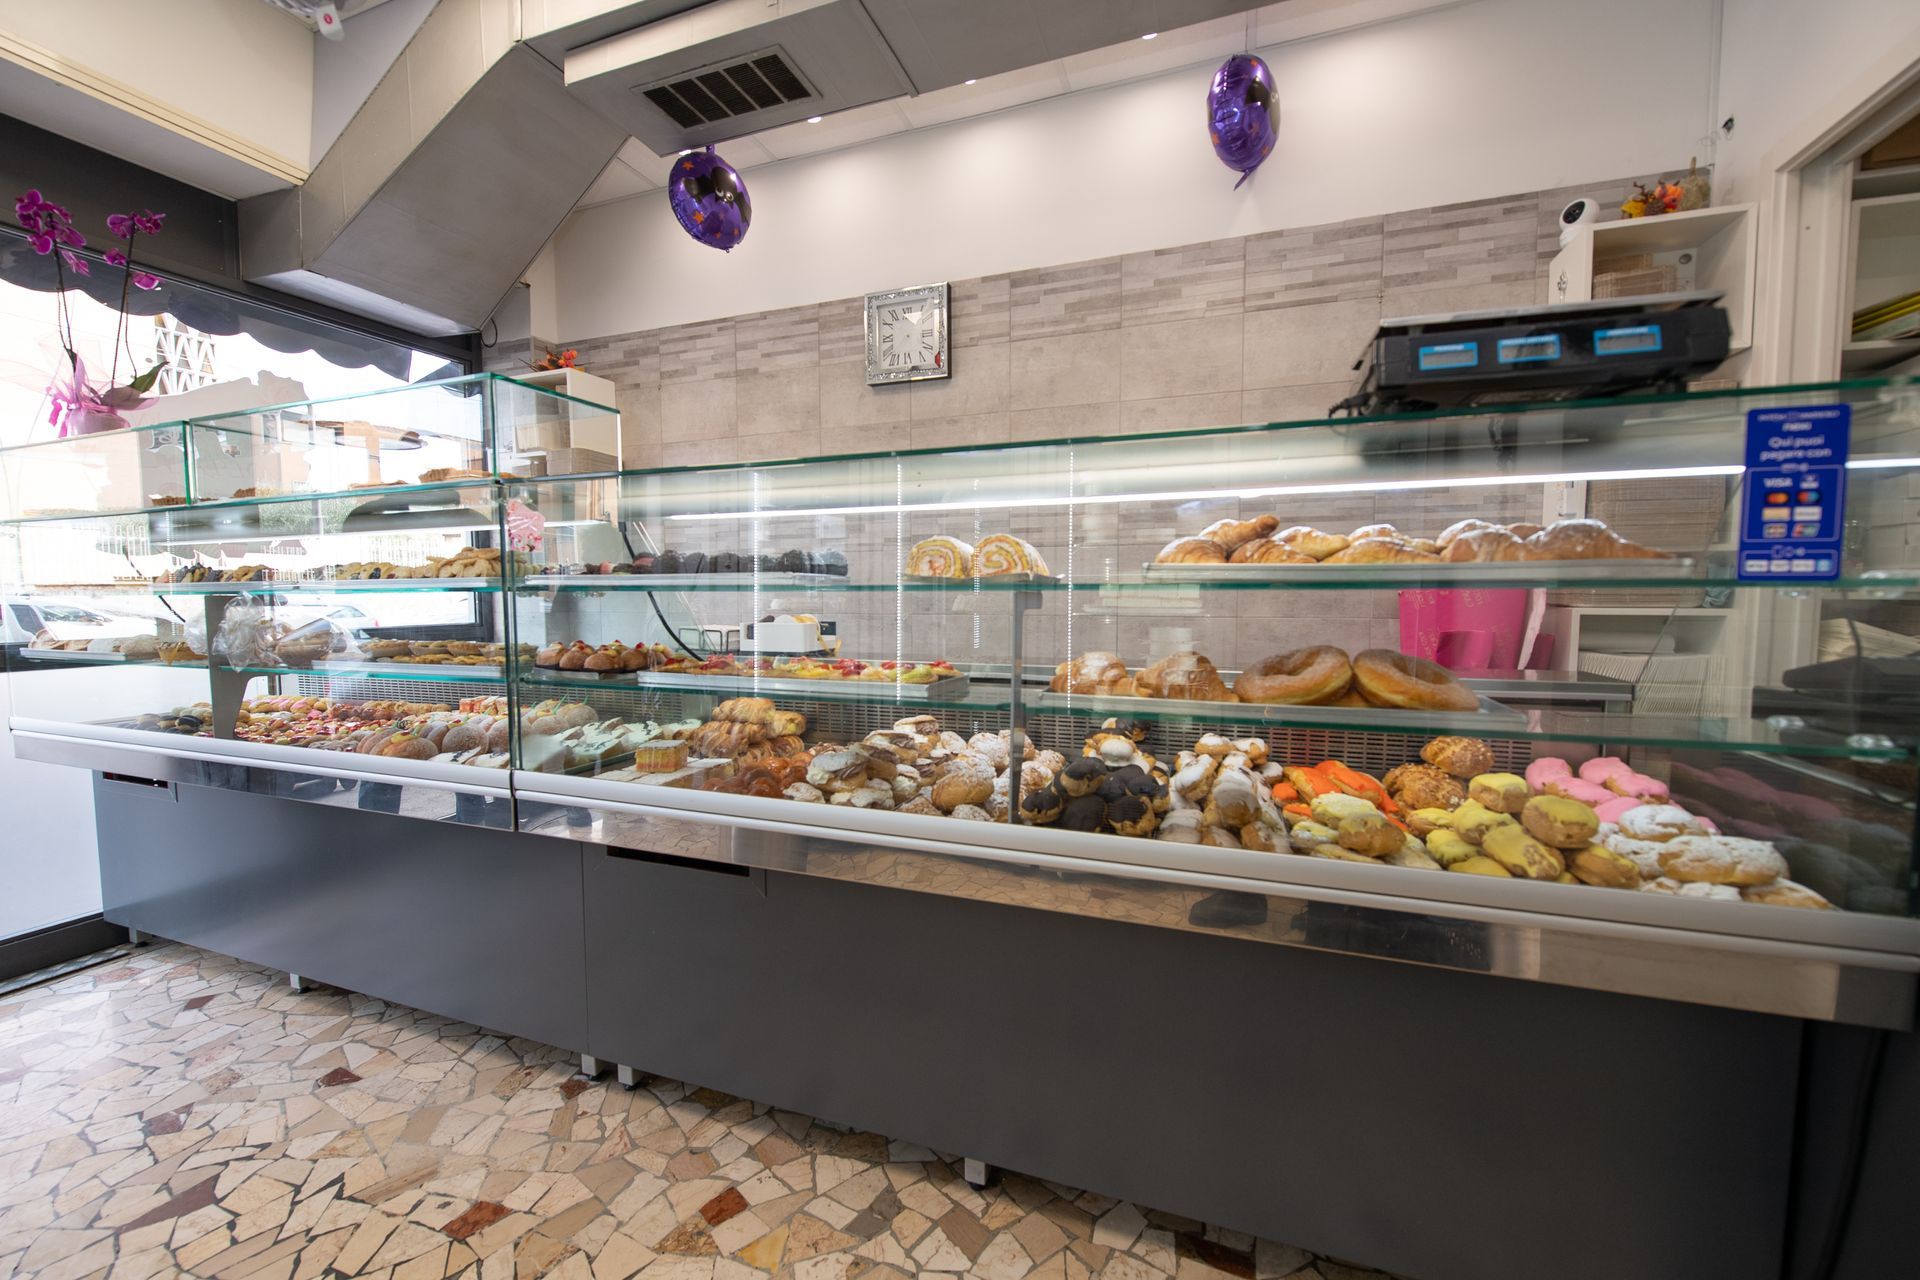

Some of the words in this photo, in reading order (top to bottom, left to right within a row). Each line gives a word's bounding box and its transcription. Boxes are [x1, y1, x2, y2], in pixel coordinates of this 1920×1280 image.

[1768, 435, 1793, 449] Qui
[1795, 435, 1825, 448] puoi
[1759, 450, 1805, 462] pagare
[1806, 449, 1832, 458] con
[1763, 477, 1793, 488] VISA
